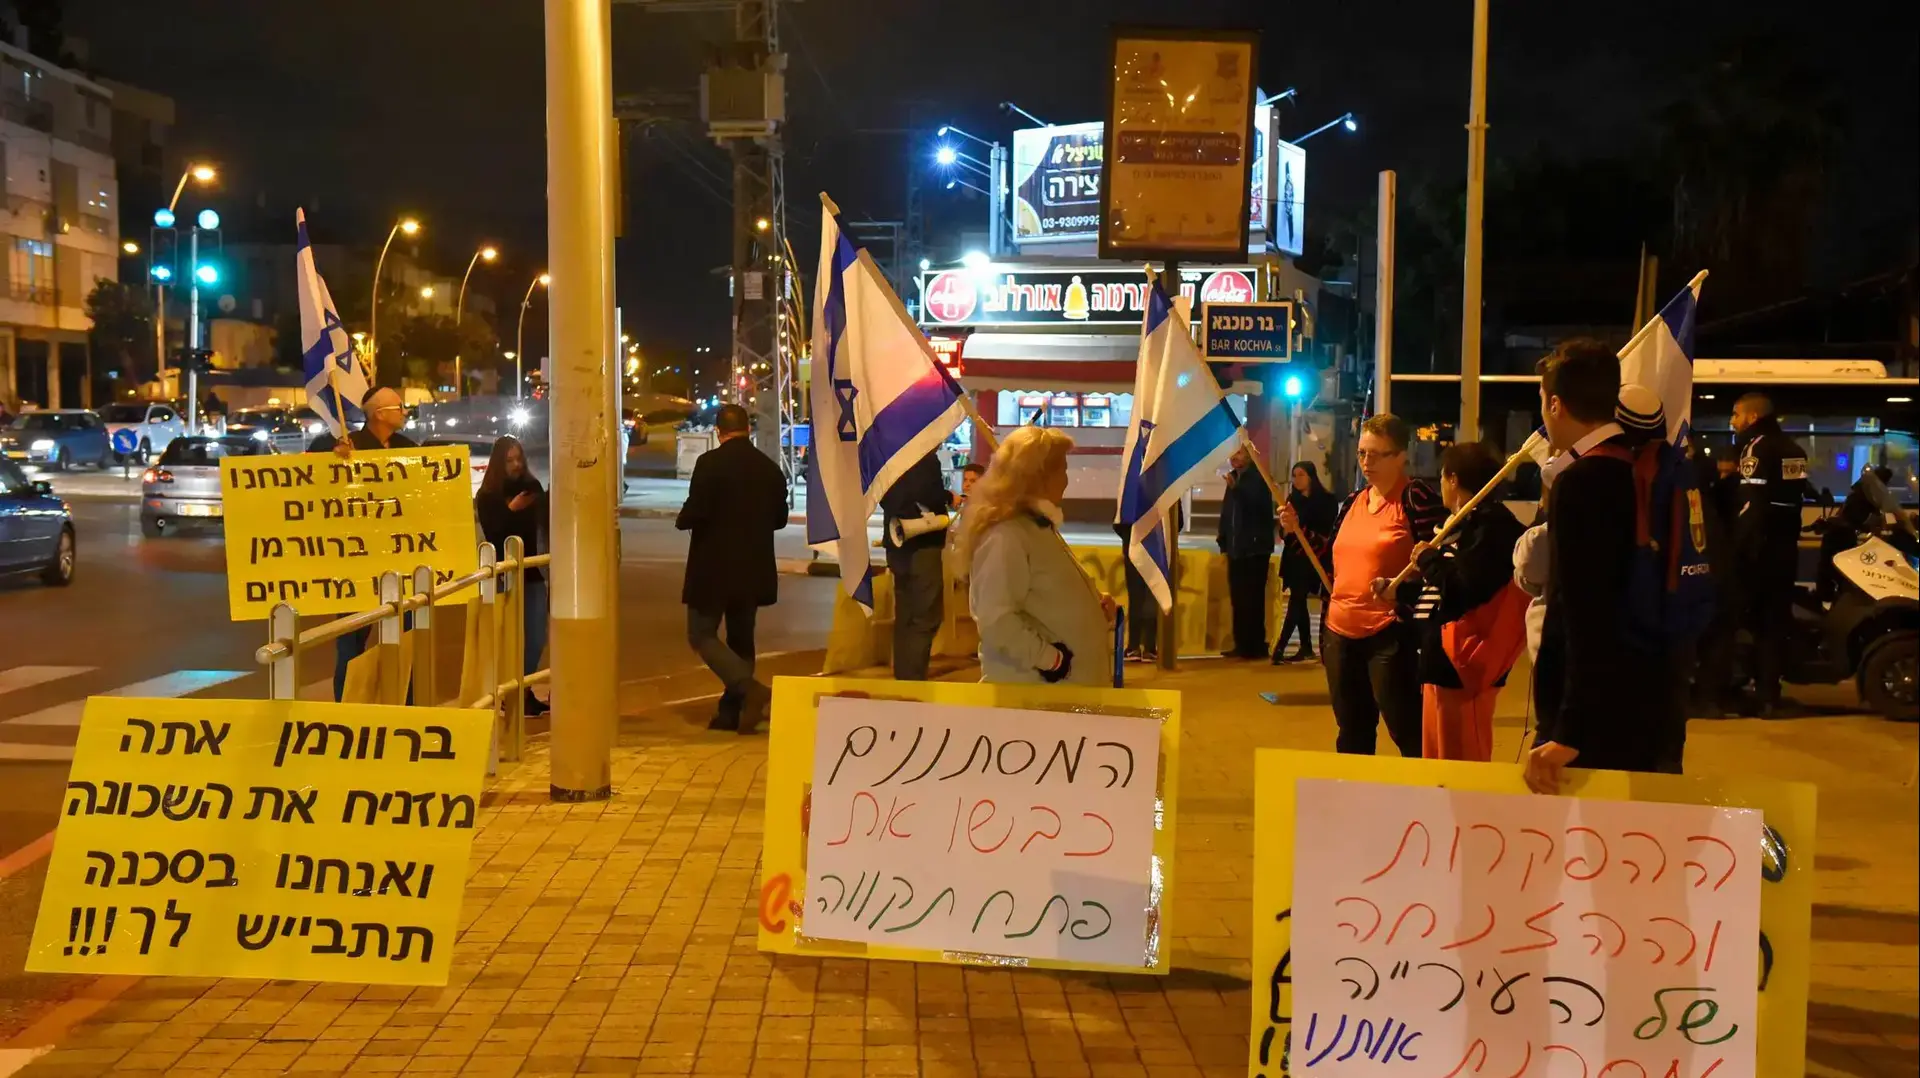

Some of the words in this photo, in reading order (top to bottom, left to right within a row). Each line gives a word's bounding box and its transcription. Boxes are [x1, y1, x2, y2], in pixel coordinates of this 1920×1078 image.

[1212, 315, 1254, 331] כוכבא
[1257, 316, 1274, 331] בר
[1211, 339, 1230, 350] BAR
[1234, 339, 1272, 352] KOCHVA
[230, 464, 315, 490] אנחנו
[328, 460, 408, 485] הבית
[421, 455, 462, 482] על
[284, 491, 403, 521] נלחמים
[250, 535, 369, 565] ברוורמן
[390, 531, 438, 554] את
[246, 578, 356, 603] מדיחים
[118, 718, 232, 756] אתה
[272, 719, 456, 768] ברוורמן
[828, 725, 1135, 788] המסתננים
[66, 780, 234, 821] השכונה
[243, 785, 318, 824] את
[341, 788, 476, 829] מזניח
[826, 792, 917, 847] את
[946, 796, 1115, 858] כבשו
[84, 848, 239, 889] בסכנה
[275, 852, 435, 899] ואנחנו
[1361, 820, 1737, 892] ההפקרות
[817, 870, 955, 931] תקווה
[972, 889, 1112, 940] פתח
[236, 913, 434, 964] תתבייש
[1335, 896, 1722, 972] וההזנחה
[1633, 987, 1739, 1044] של
[1305, 1012, 1423, 1068] אותנו
